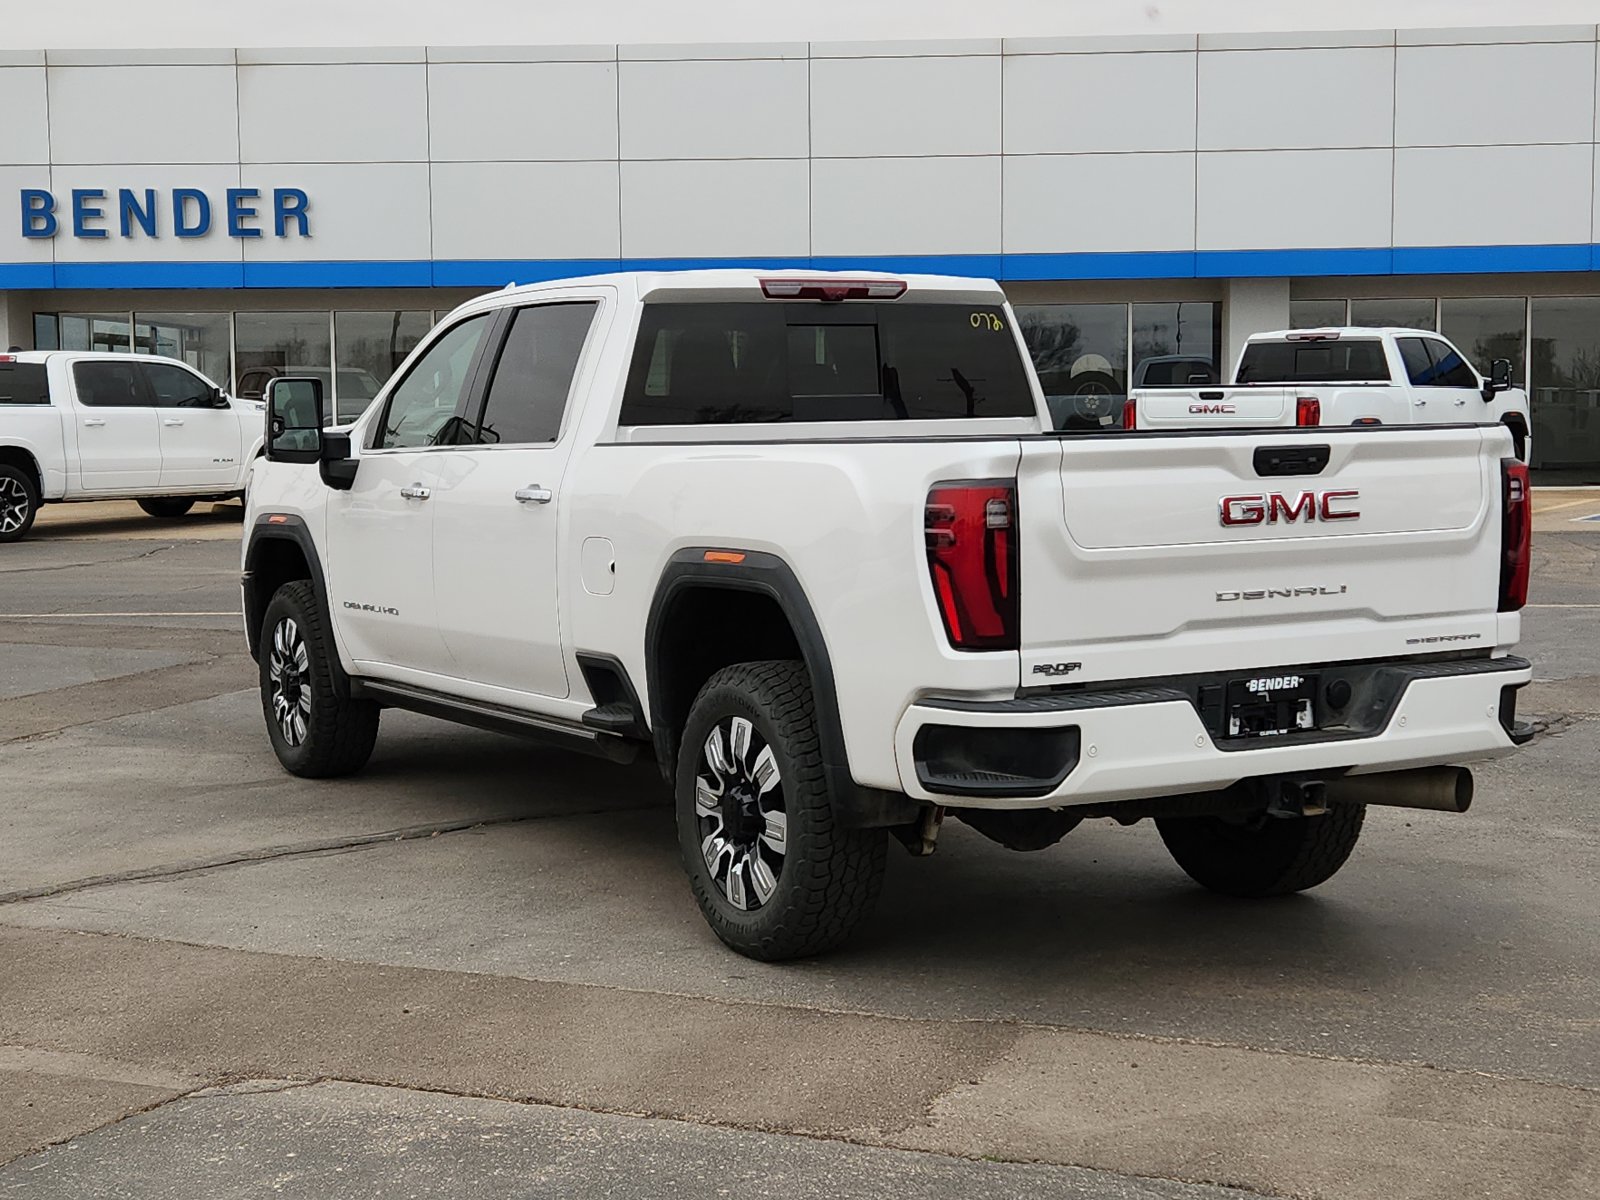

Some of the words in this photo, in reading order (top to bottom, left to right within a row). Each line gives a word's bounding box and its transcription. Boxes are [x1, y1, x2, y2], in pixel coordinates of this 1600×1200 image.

[20, 188, 312, 238] BENDER
[970, 313, 1003, 330] 072
[1189, 404, 1236, 414] GMC
[1219, 489, 1360, 527] GMC
[1216, 584, 1346, 602] DENALI
[1405, 633, 1481, 645] SIERRA
[1032, 661, 1082, 674] BENDER
[1248, 676, 1299, 692] BENDER
